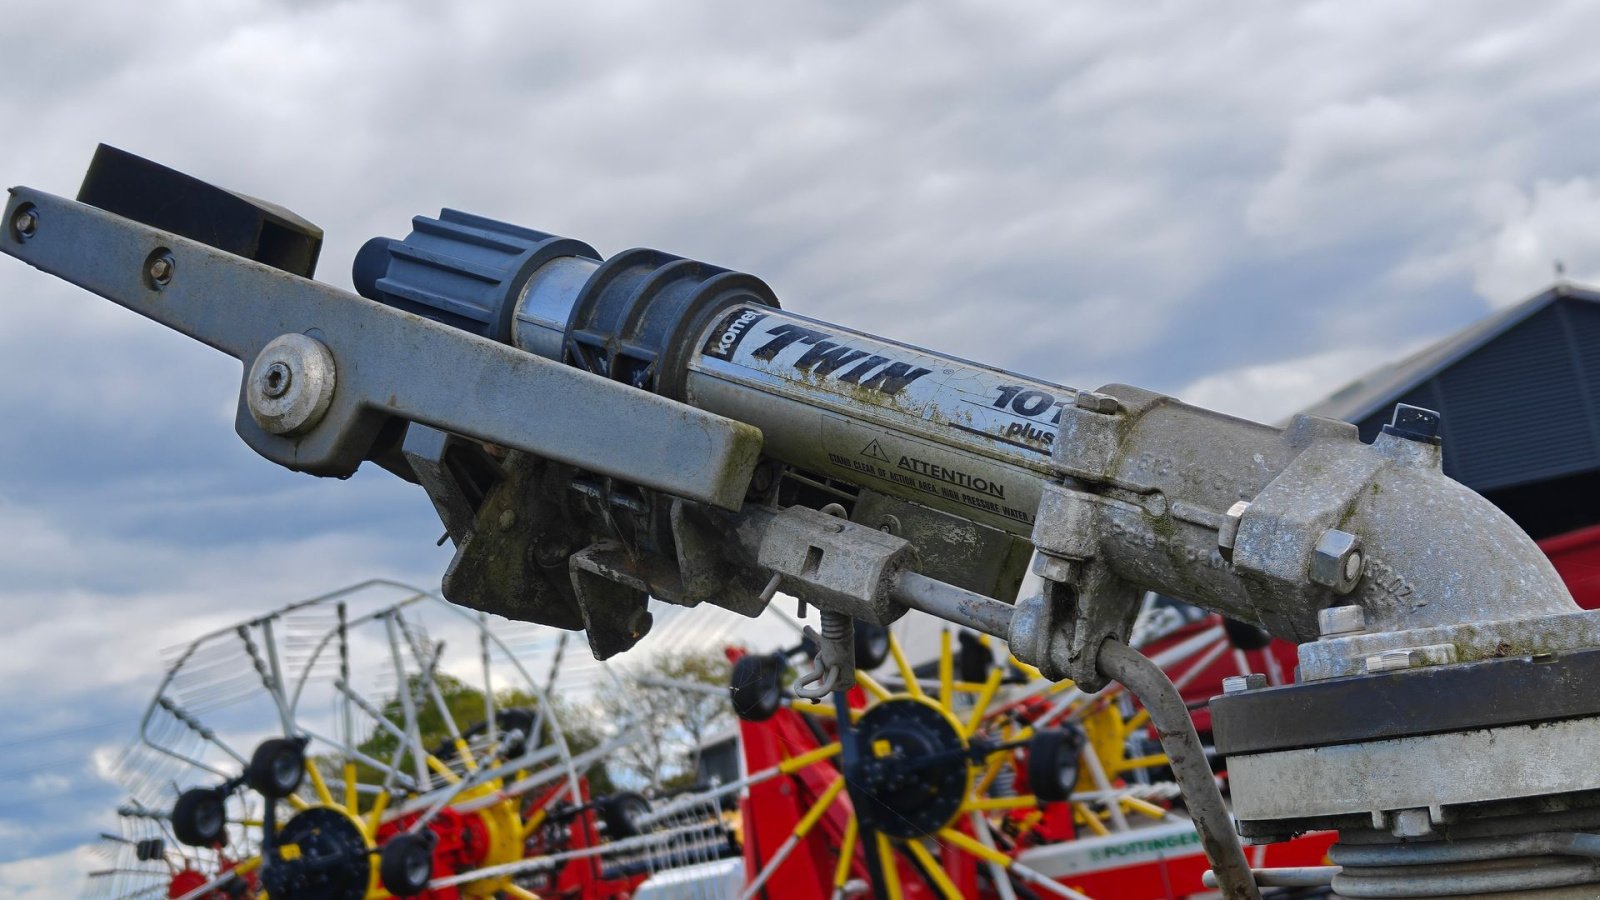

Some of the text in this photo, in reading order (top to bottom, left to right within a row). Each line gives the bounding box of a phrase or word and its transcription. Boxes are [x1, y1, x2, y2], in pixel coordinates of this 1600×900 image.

[712, 310, 762, 355] komet
[751, 324, 934, 396] TWIN
[1005, 421, 1056, 446] plus
[828, 452, 852, 469] STAND
[853, 460, 876, 475] CLEAR
[878, 467, 887, 478] OF
[890, 471, 916, 488] ACTION
[941, 486, 960, 501] HIGH
[962, 493, 1000, 514] PRESSURE
[1002, 505, 1028, 521] WATER
[898, 455, 1004, 497] ATTENTION
